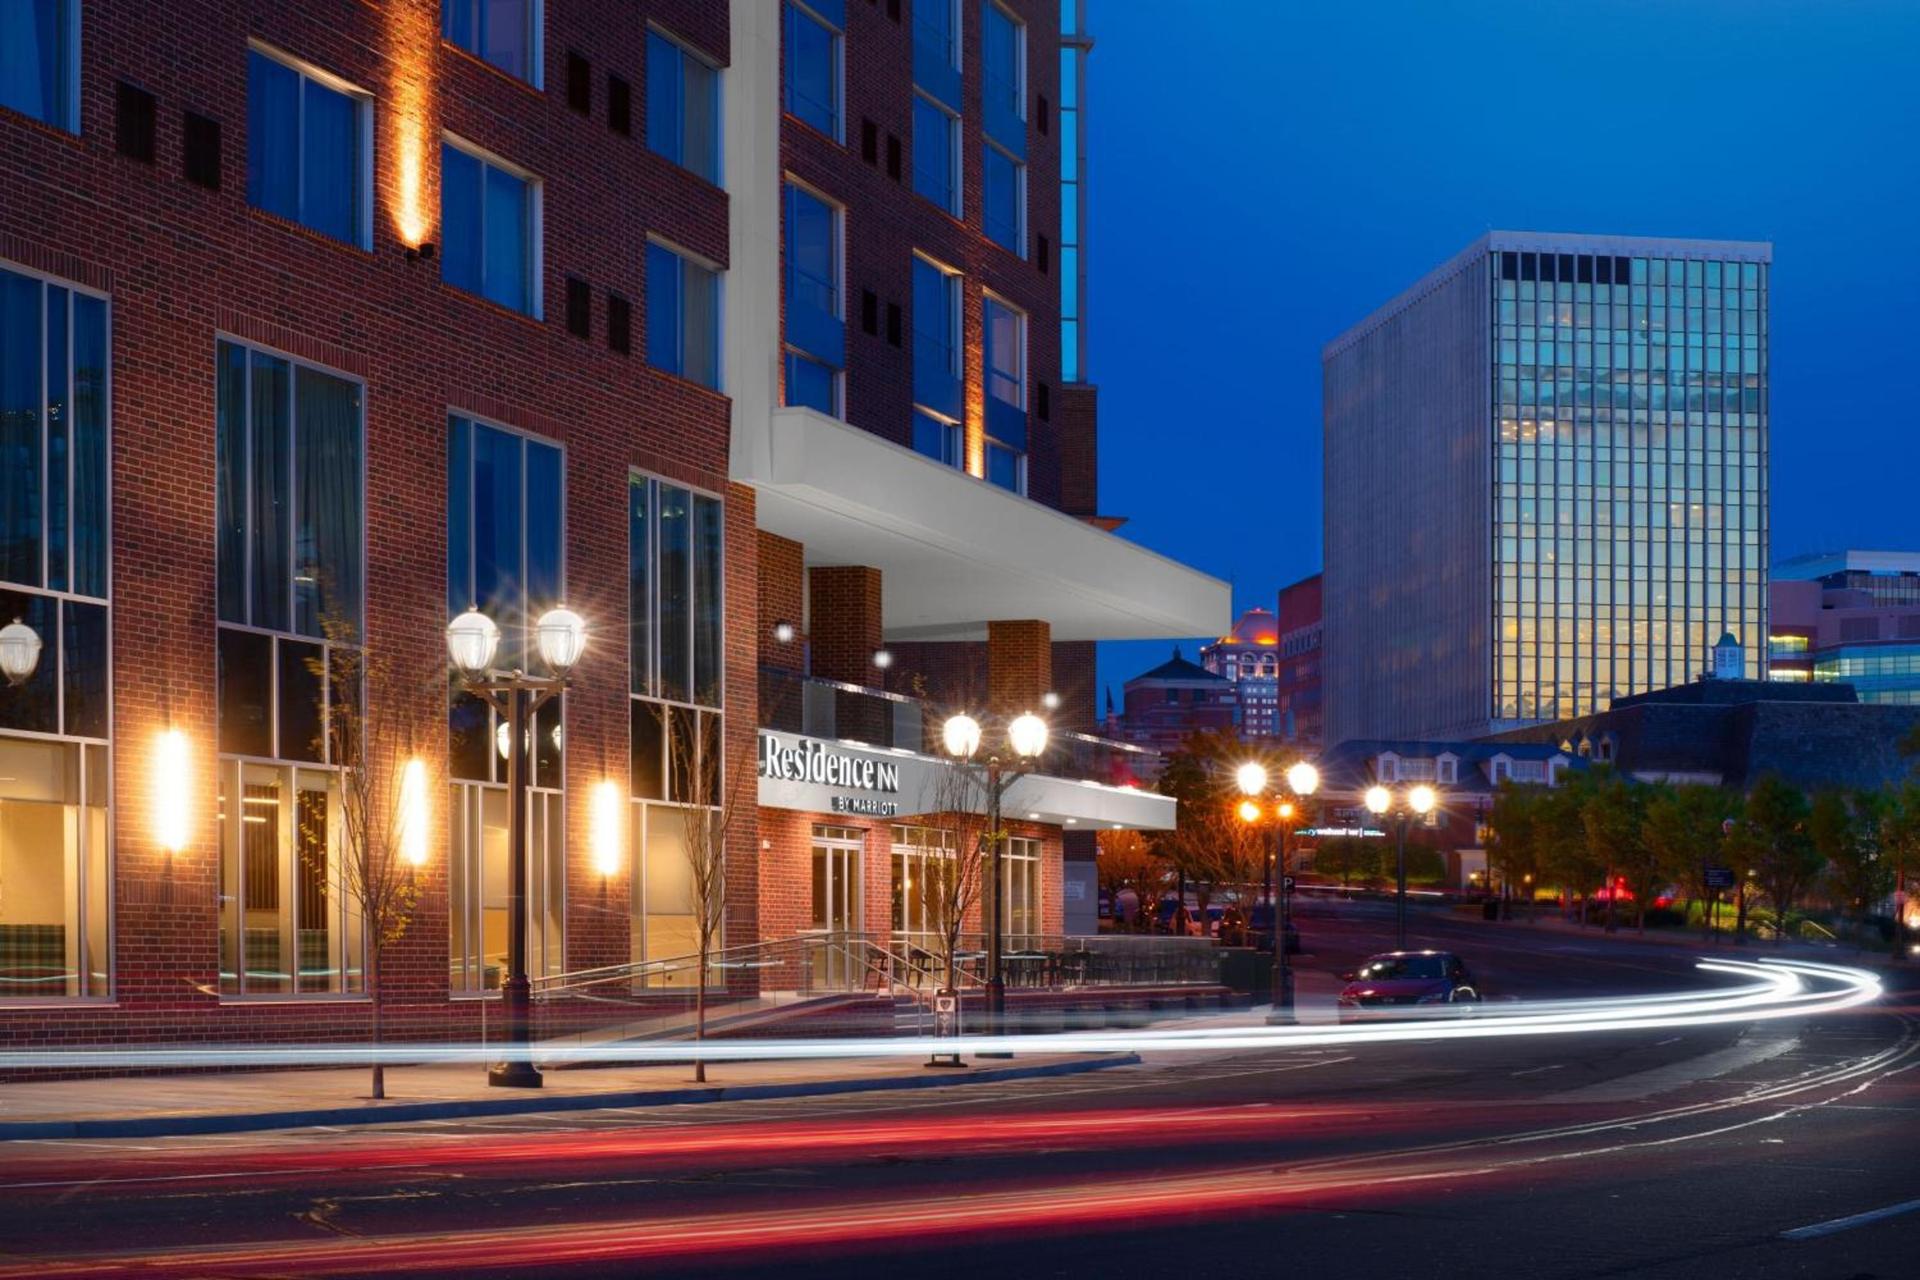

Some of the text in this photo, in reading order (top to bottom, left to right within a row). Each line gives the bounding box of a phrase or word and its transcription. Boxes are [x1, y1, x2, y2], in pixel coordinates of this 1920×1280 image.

[766, 735, 874, 789] Residence
[839, 796, 898, 815] BY MARRIOTT
[1284, 877, 1293, 889] P
